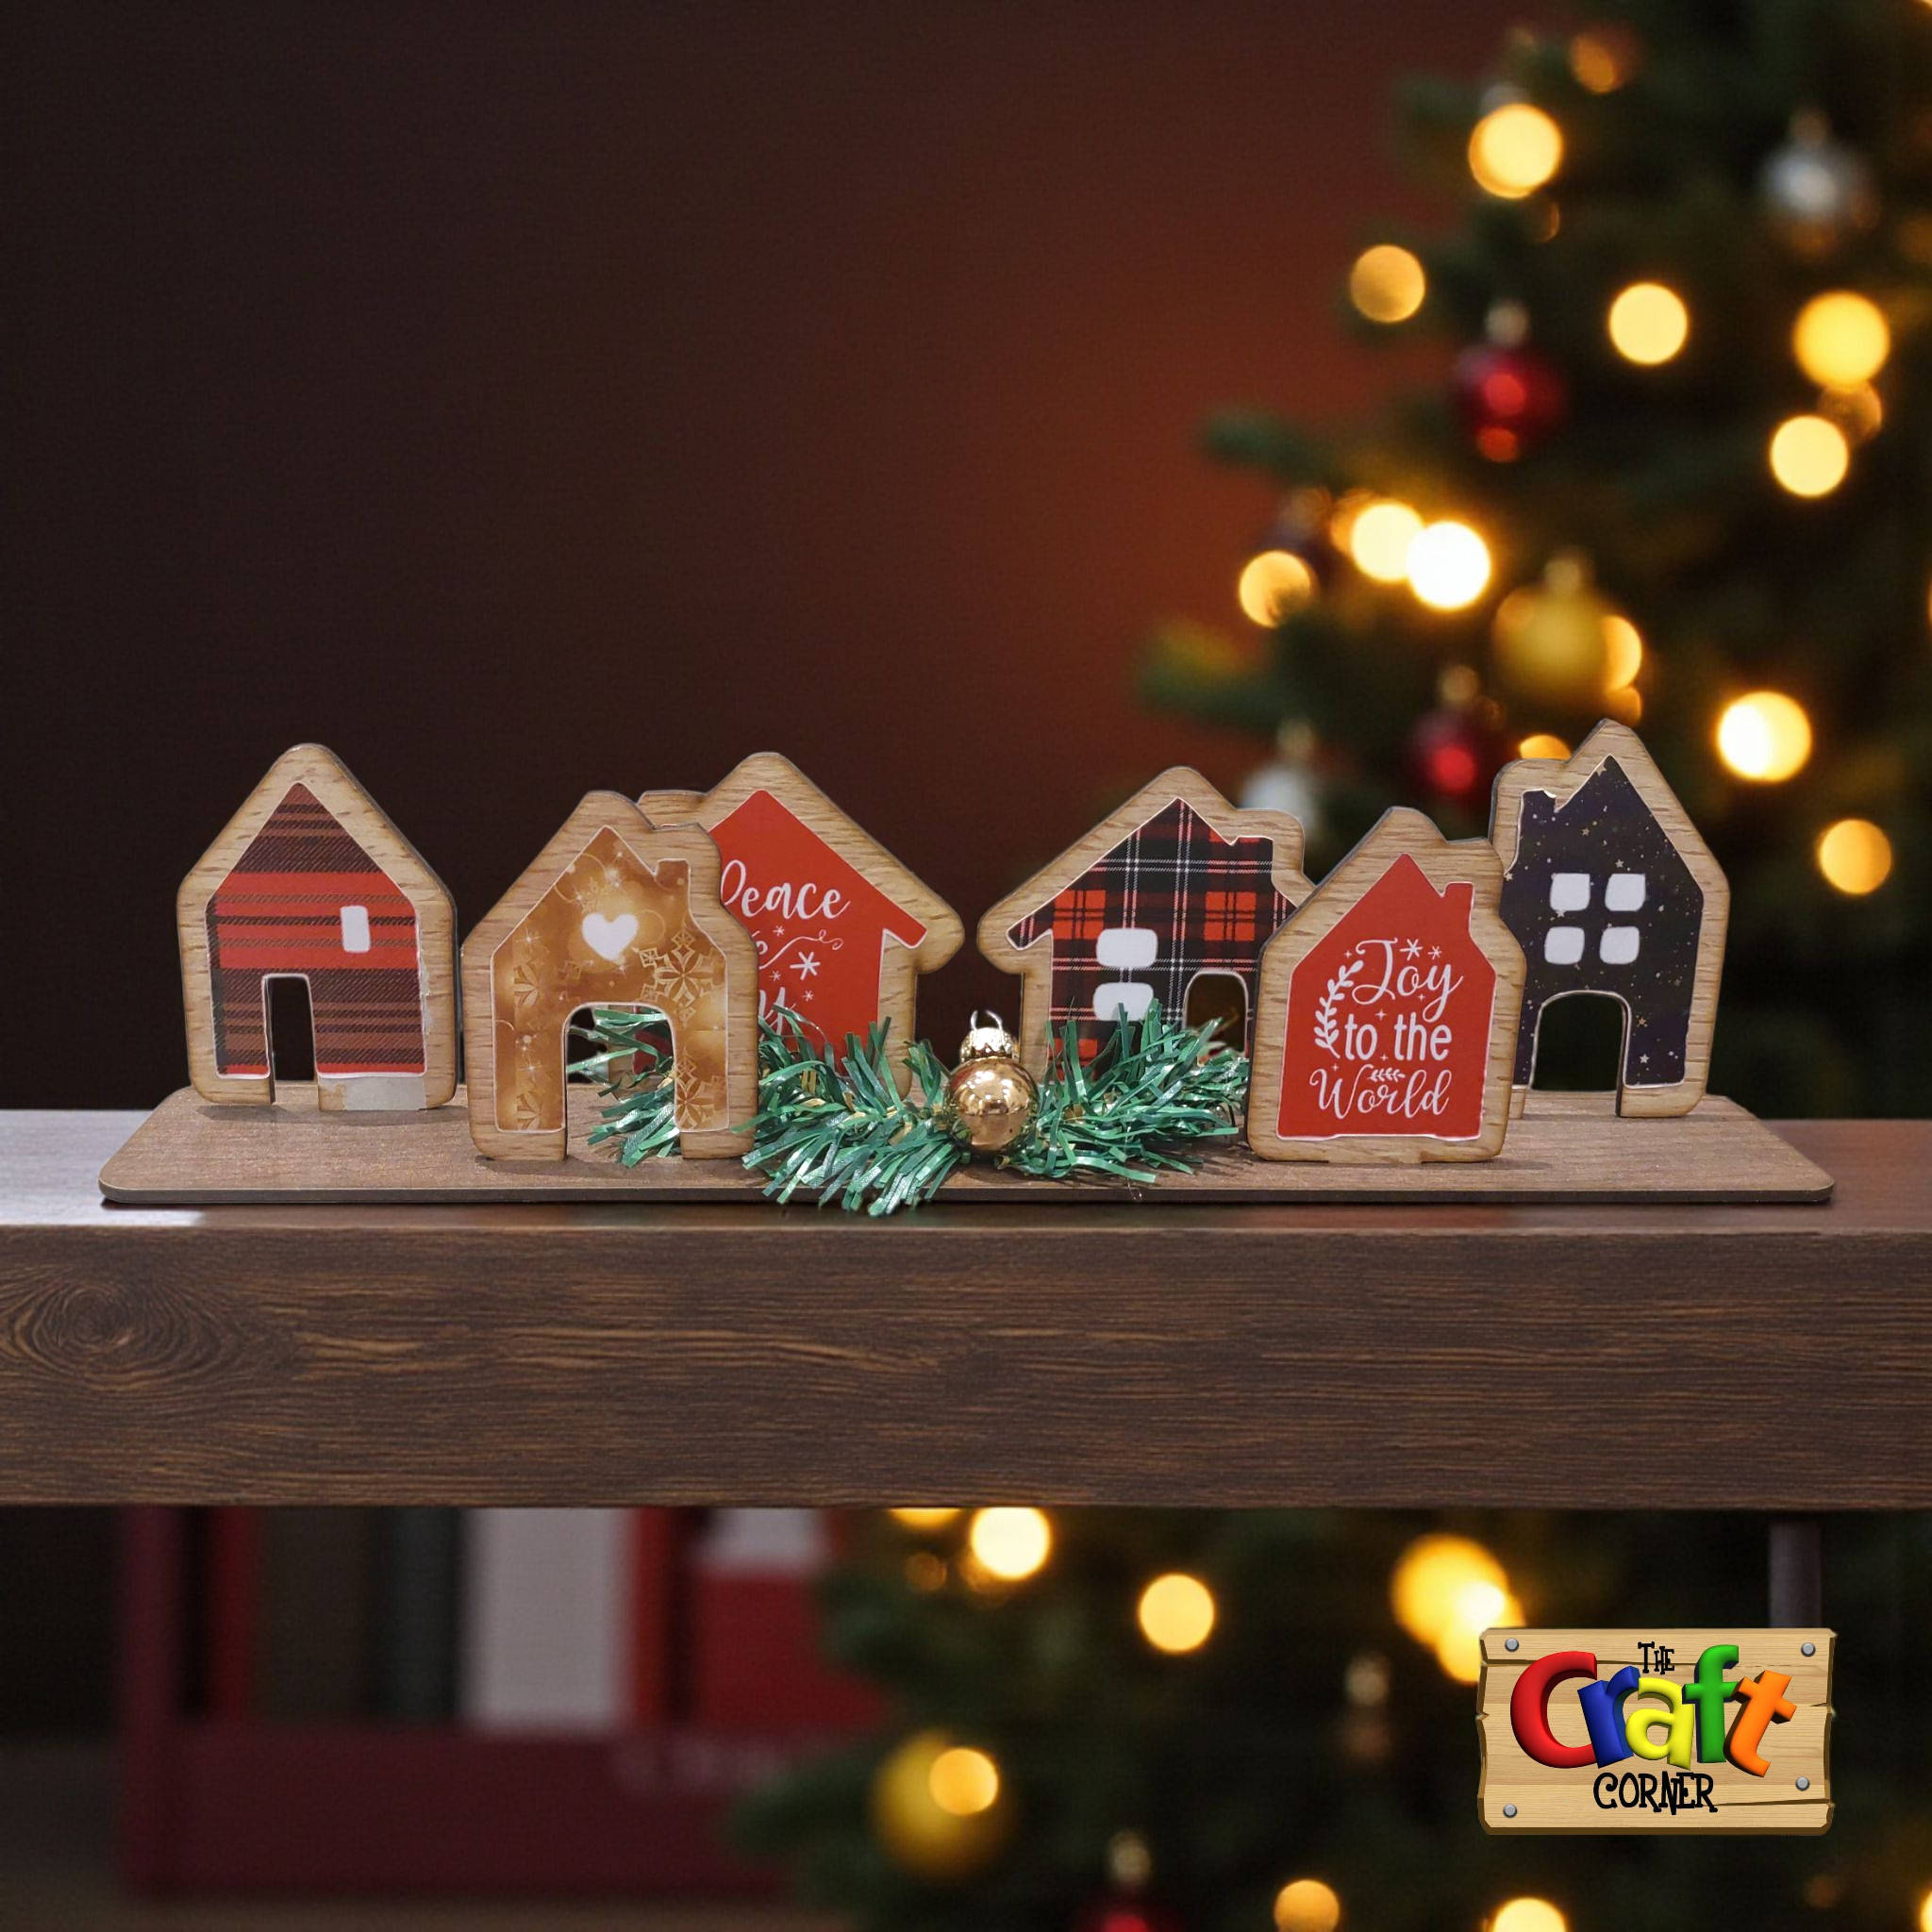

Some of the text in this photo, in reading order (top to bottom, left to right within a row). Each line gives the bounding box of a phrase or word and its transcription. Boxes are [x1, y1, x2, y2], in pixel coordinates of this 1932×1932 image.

[1352, 938, 1463, 1023] Joy
[1344, 1011, 1452, 1061] to the
[1309, 1064, 1452, 1120] World
